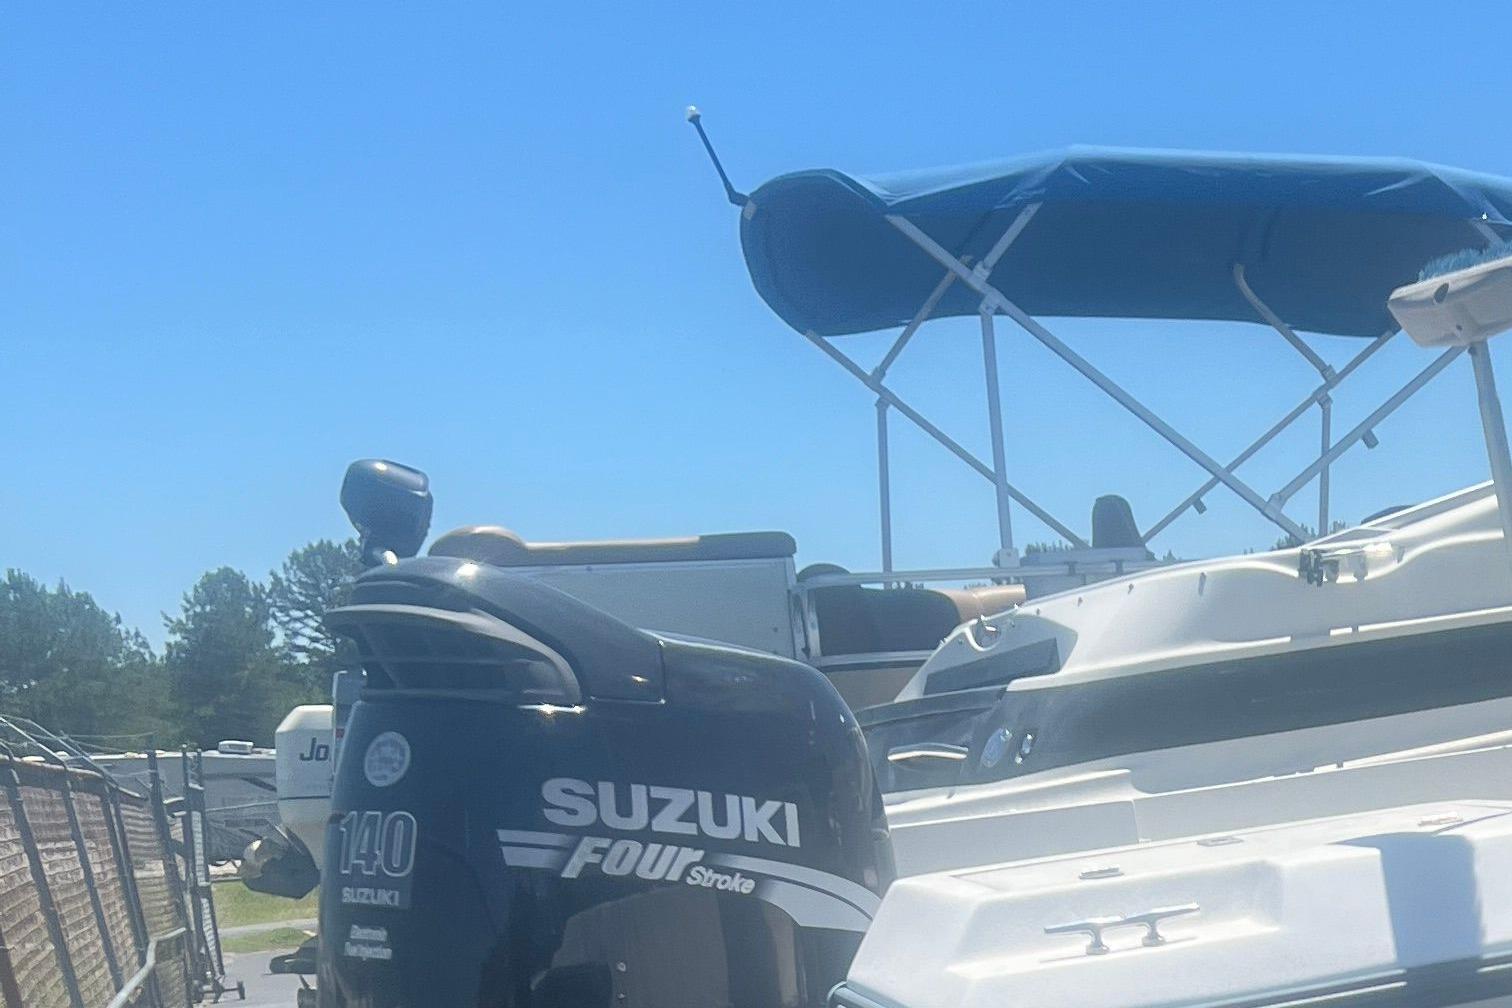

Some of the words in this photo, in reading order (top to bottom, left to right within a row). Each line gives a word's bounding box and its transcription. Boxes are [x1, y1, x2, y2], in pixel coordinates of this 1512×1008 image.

[300, 737, 330, 761] Jo
[541, 777, 800, 847] SUZUKI
[340, 811, 417, 877] 140
[686, 865, 755, 894] Stroke
[341, 886, 400, 906] SUZUKI
